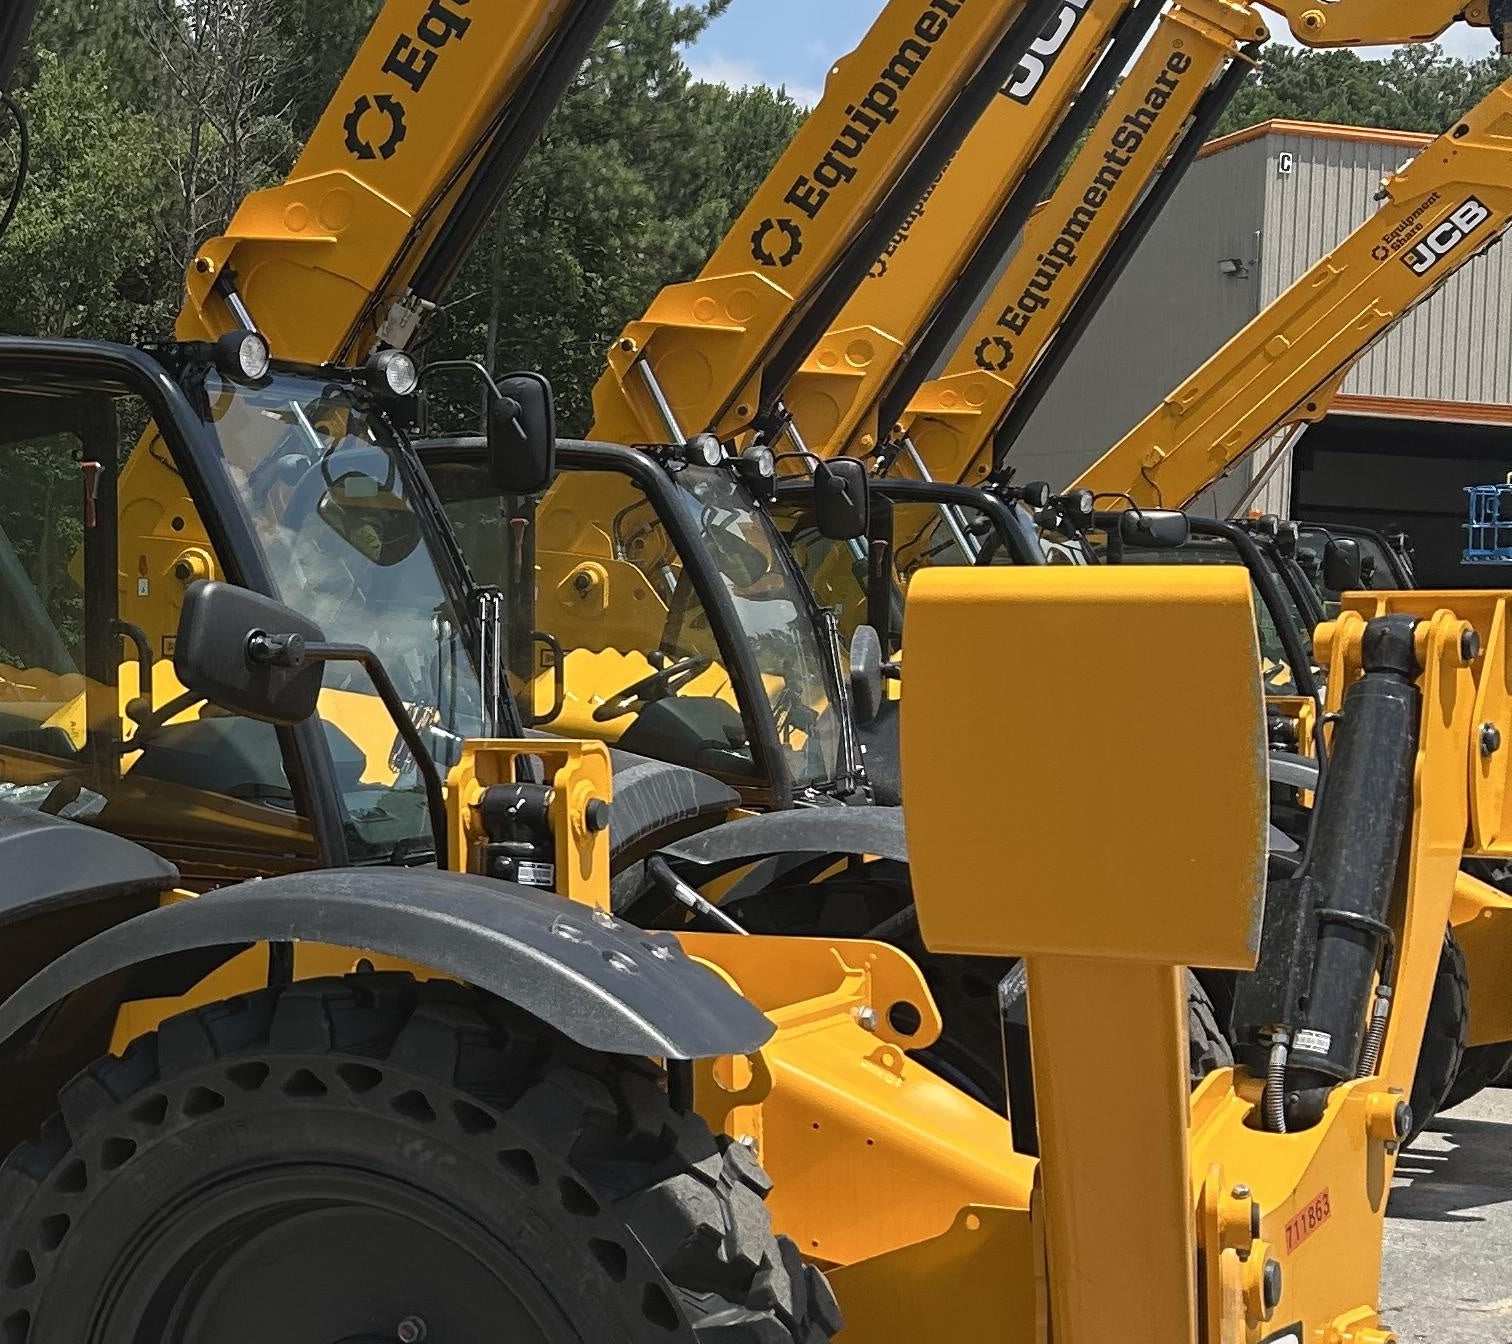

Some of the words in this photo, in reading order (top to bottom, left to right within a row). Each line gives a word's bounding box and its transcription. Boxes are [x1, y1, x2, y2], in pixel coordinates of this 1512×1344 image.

[1281, 155, 1290, 171] C
[1382, 191, 1442, 244] Equipment
[1389, 222, 1424, 252] Share
[1412, 200, 1488, 273] JCB
[1285, 1193, 1330, 1248] 711863
